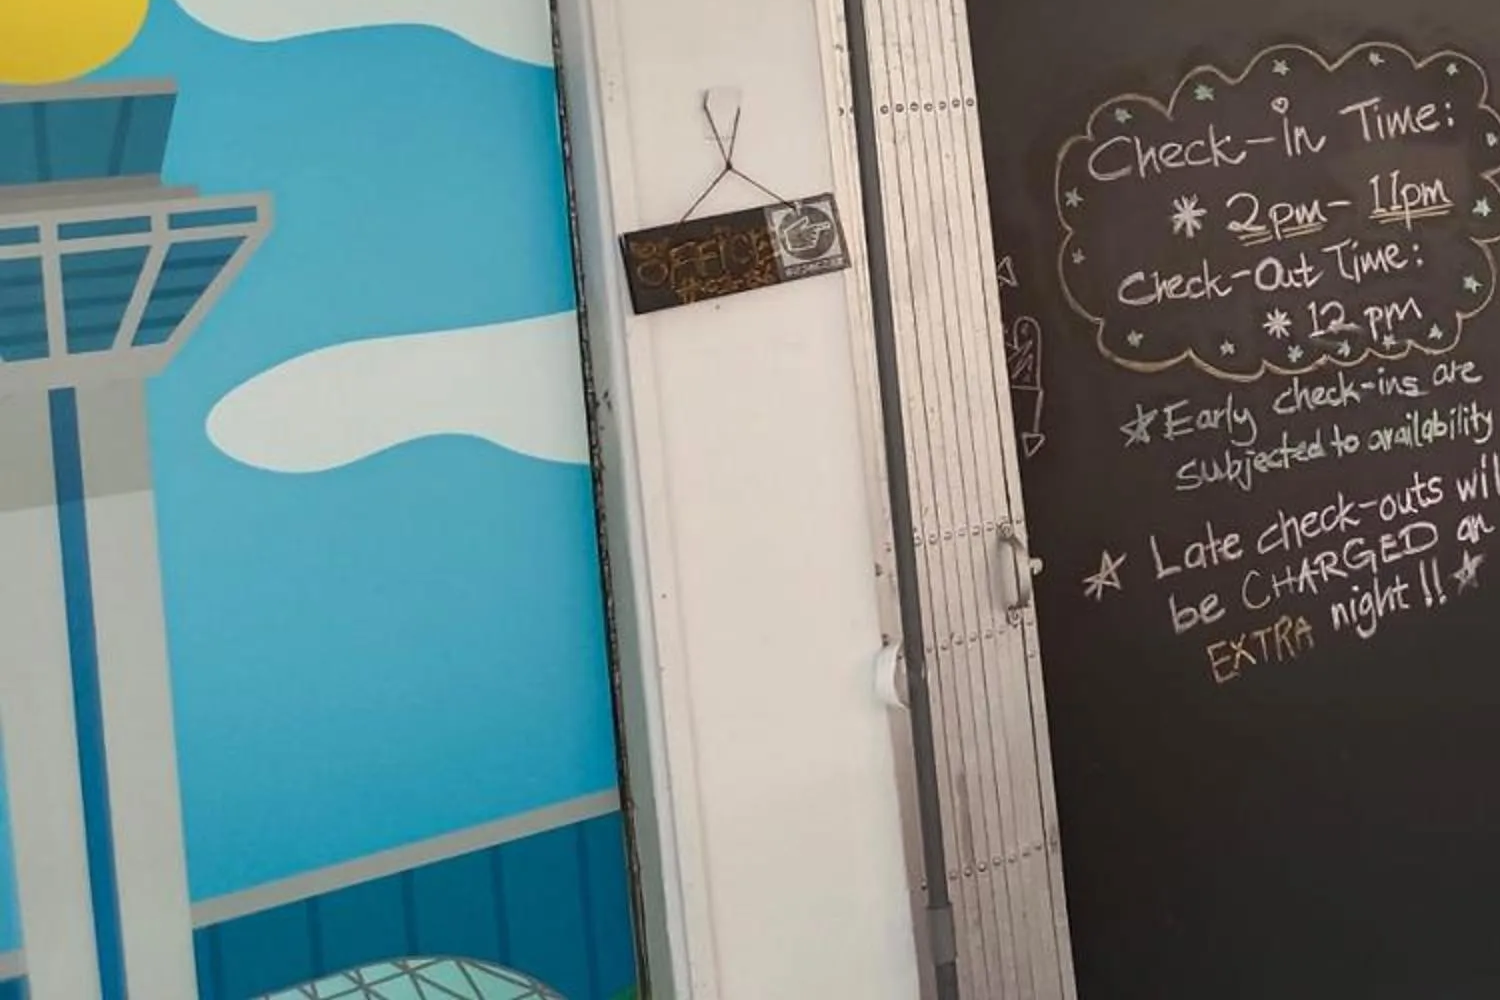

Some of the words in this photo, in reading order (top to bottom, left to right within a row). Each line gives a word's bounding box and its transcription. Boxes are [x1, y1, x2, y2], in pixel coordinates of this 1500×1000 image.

[1340, 97, 1455, 144] Time:
[1322, 238, 1425, 283] Time:
[1164, 393, 1258, 447] Early
[1272, 368, 1430, 416] check-ins
[1432, 359, 1483, 387] are
[1330, 426, 1360, 457] to
[1367, 402, 1494, 450] availability
[1150, 520, 1245, 579] Late
[1257, 474, 1444, 554] check-outs
[1168, 592, 1227, 635] be
[1241, 522, 1439, 609] CHARGED
[1457, 512, 1495, 543] an
[1207, 614, 1314, 684] EXTRA
